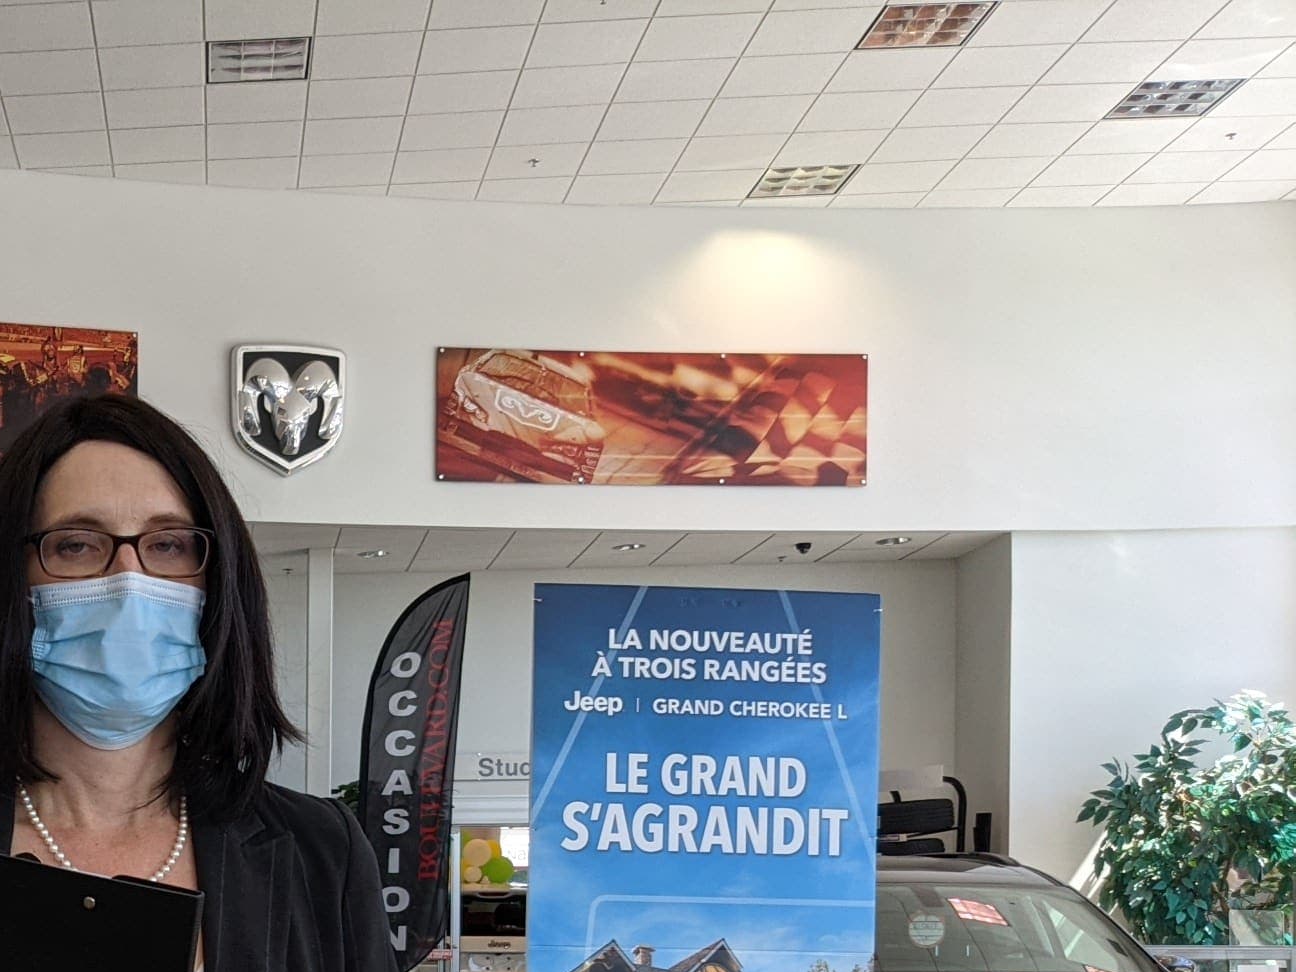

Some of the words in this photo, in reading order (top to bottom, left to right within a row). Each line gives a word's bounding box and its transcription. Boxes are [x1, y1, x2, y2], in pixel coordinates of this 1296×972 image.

[608, 628, 642, 650] LA
[650, 629, 813, 655] NOUVEAUTÉ
[591, 651, 612, 677] À
[618, 656, 696, 680] TROIS
[703, 657, 827, 684] RANGÉES
[564, 690, 623, 716] Jeep
[652, 698, 724, 716] GRAND
[729, 700, 831, 719] CHEROKEE
[837, 703, 847, 720] L
[606, 752, 649, 794] LE
[661, 754, 807, 798] GRAND
[382, 651, 422, 952] OCCASION
[560, 801, 849, 856] S'AGRANDIT
